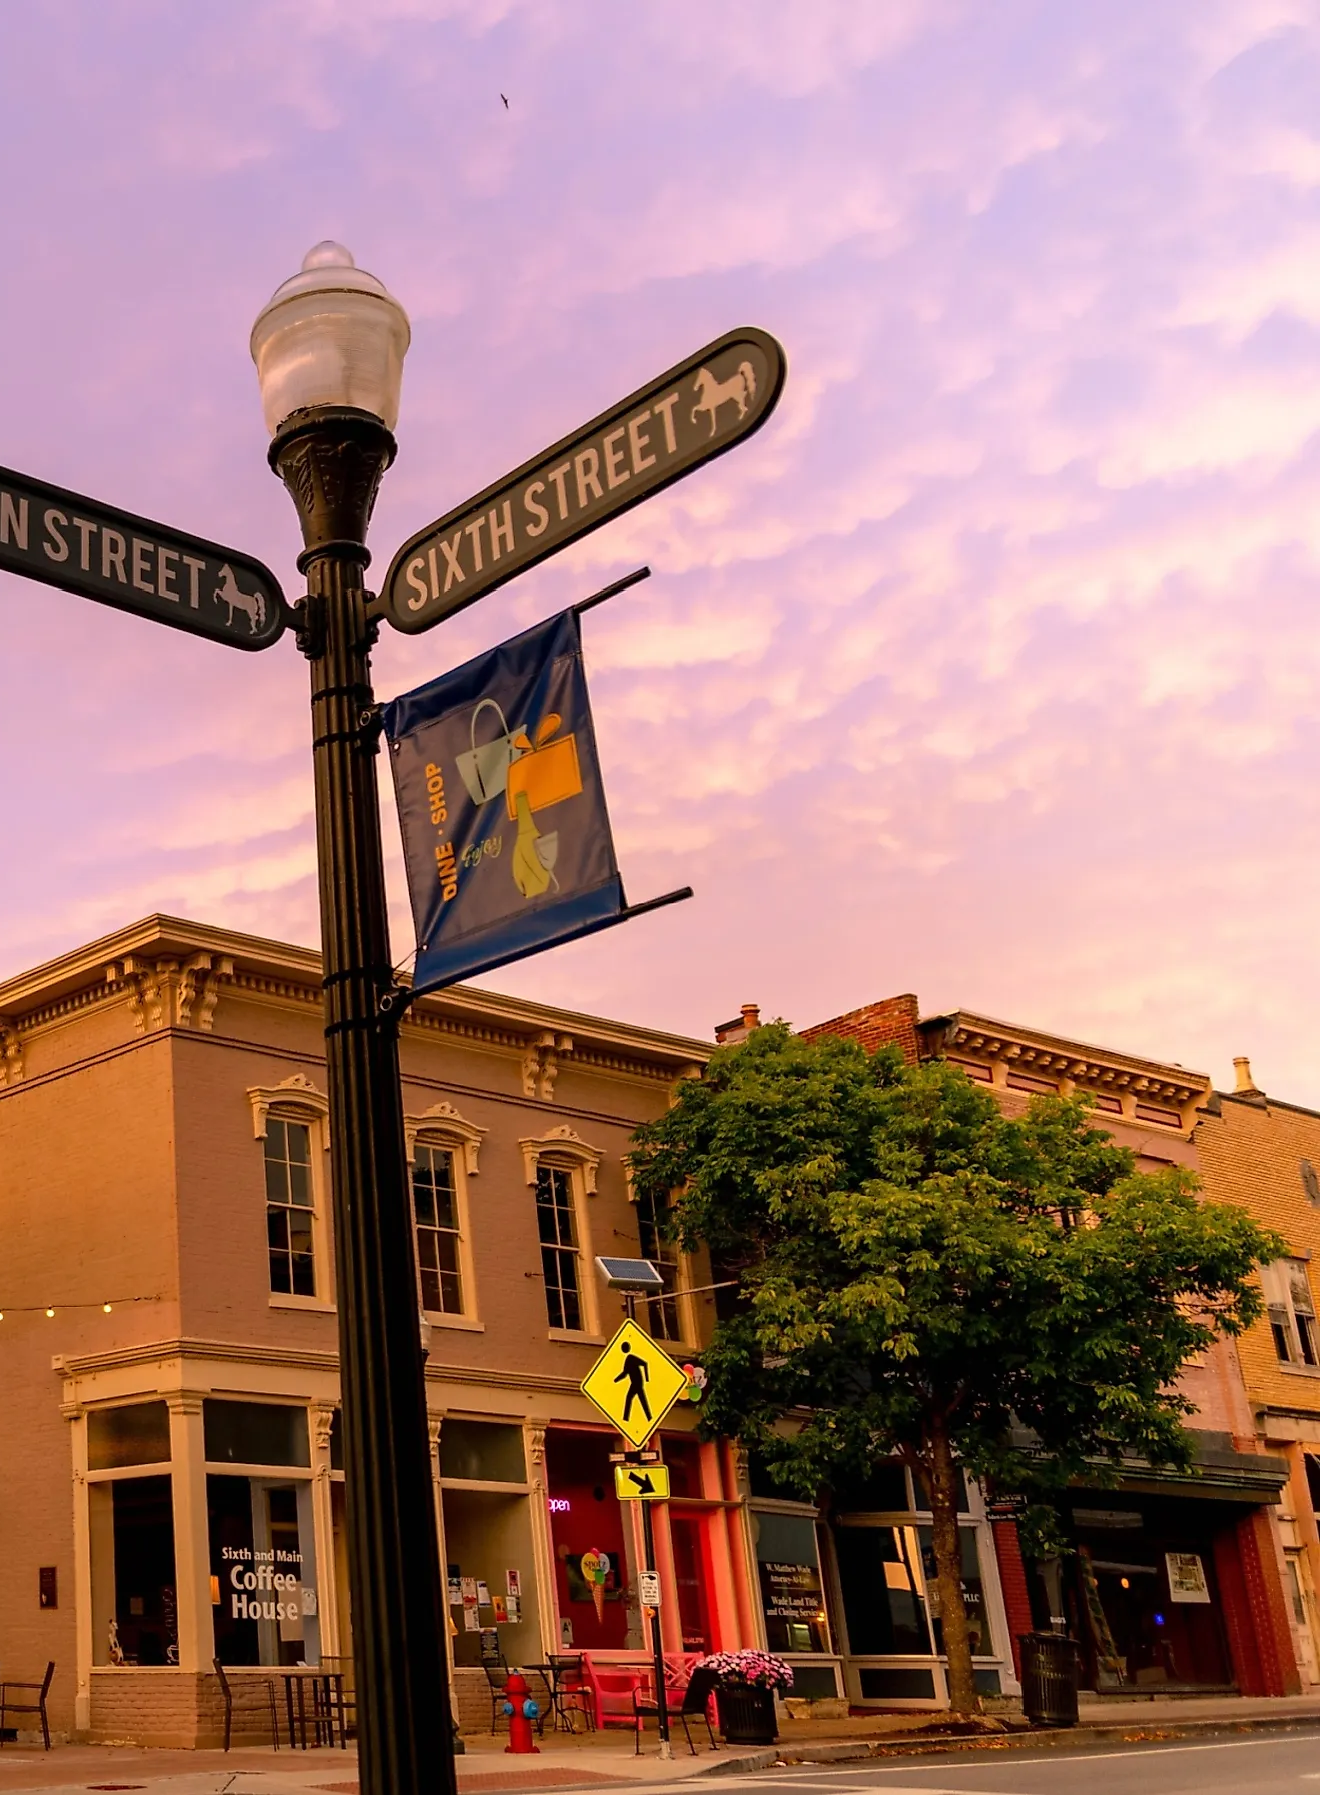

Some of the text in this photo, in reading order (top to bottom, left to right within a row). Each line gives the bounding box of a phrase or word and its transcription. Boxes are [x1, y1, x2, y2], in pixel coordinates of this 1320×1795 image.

[405, 392, 680, 612] SIXTH STREET
[42, 508, 206, 610] STREET
[425, 762, 458, 902] DINE SHOP
[461, 835, 502, 868] Enjoy
[221, 1547, 303, 1562] Sixth and Main
[230, 1565, 297, 1591] Coffee
[231, 1593, 298, 1620] House
[789, 1597, 804, 1606] Land
